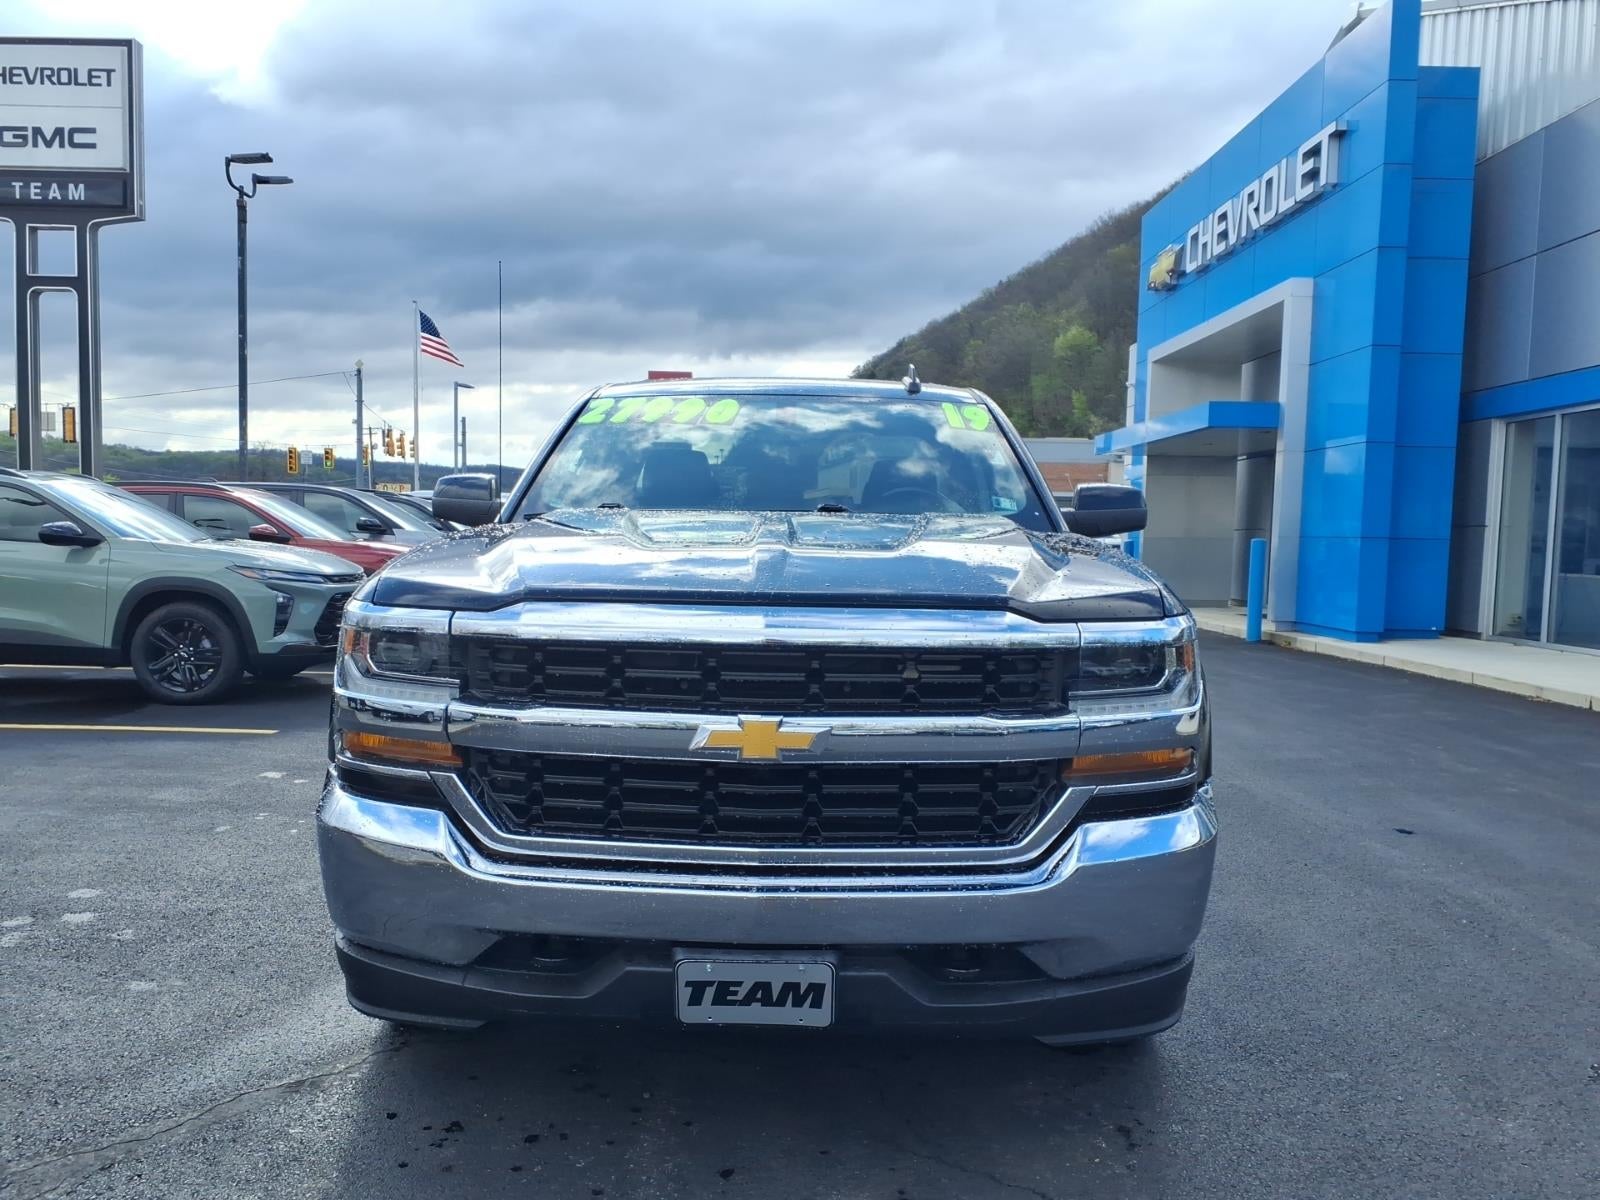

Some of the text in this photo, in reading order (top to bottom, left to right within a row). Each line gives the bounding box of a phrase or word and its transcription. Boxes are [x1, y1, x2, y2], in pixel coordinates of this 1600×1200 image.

[0, 66, 116, 87] HEVROLET
[0, 126, 97, 149] GMC
[11, 182, 85, 201] TEAM
[1186, 121, 1346, 273] CHEVROLET
[941, 402, 989, 430] 19
[684, 980, 826, 1009] TEAM
